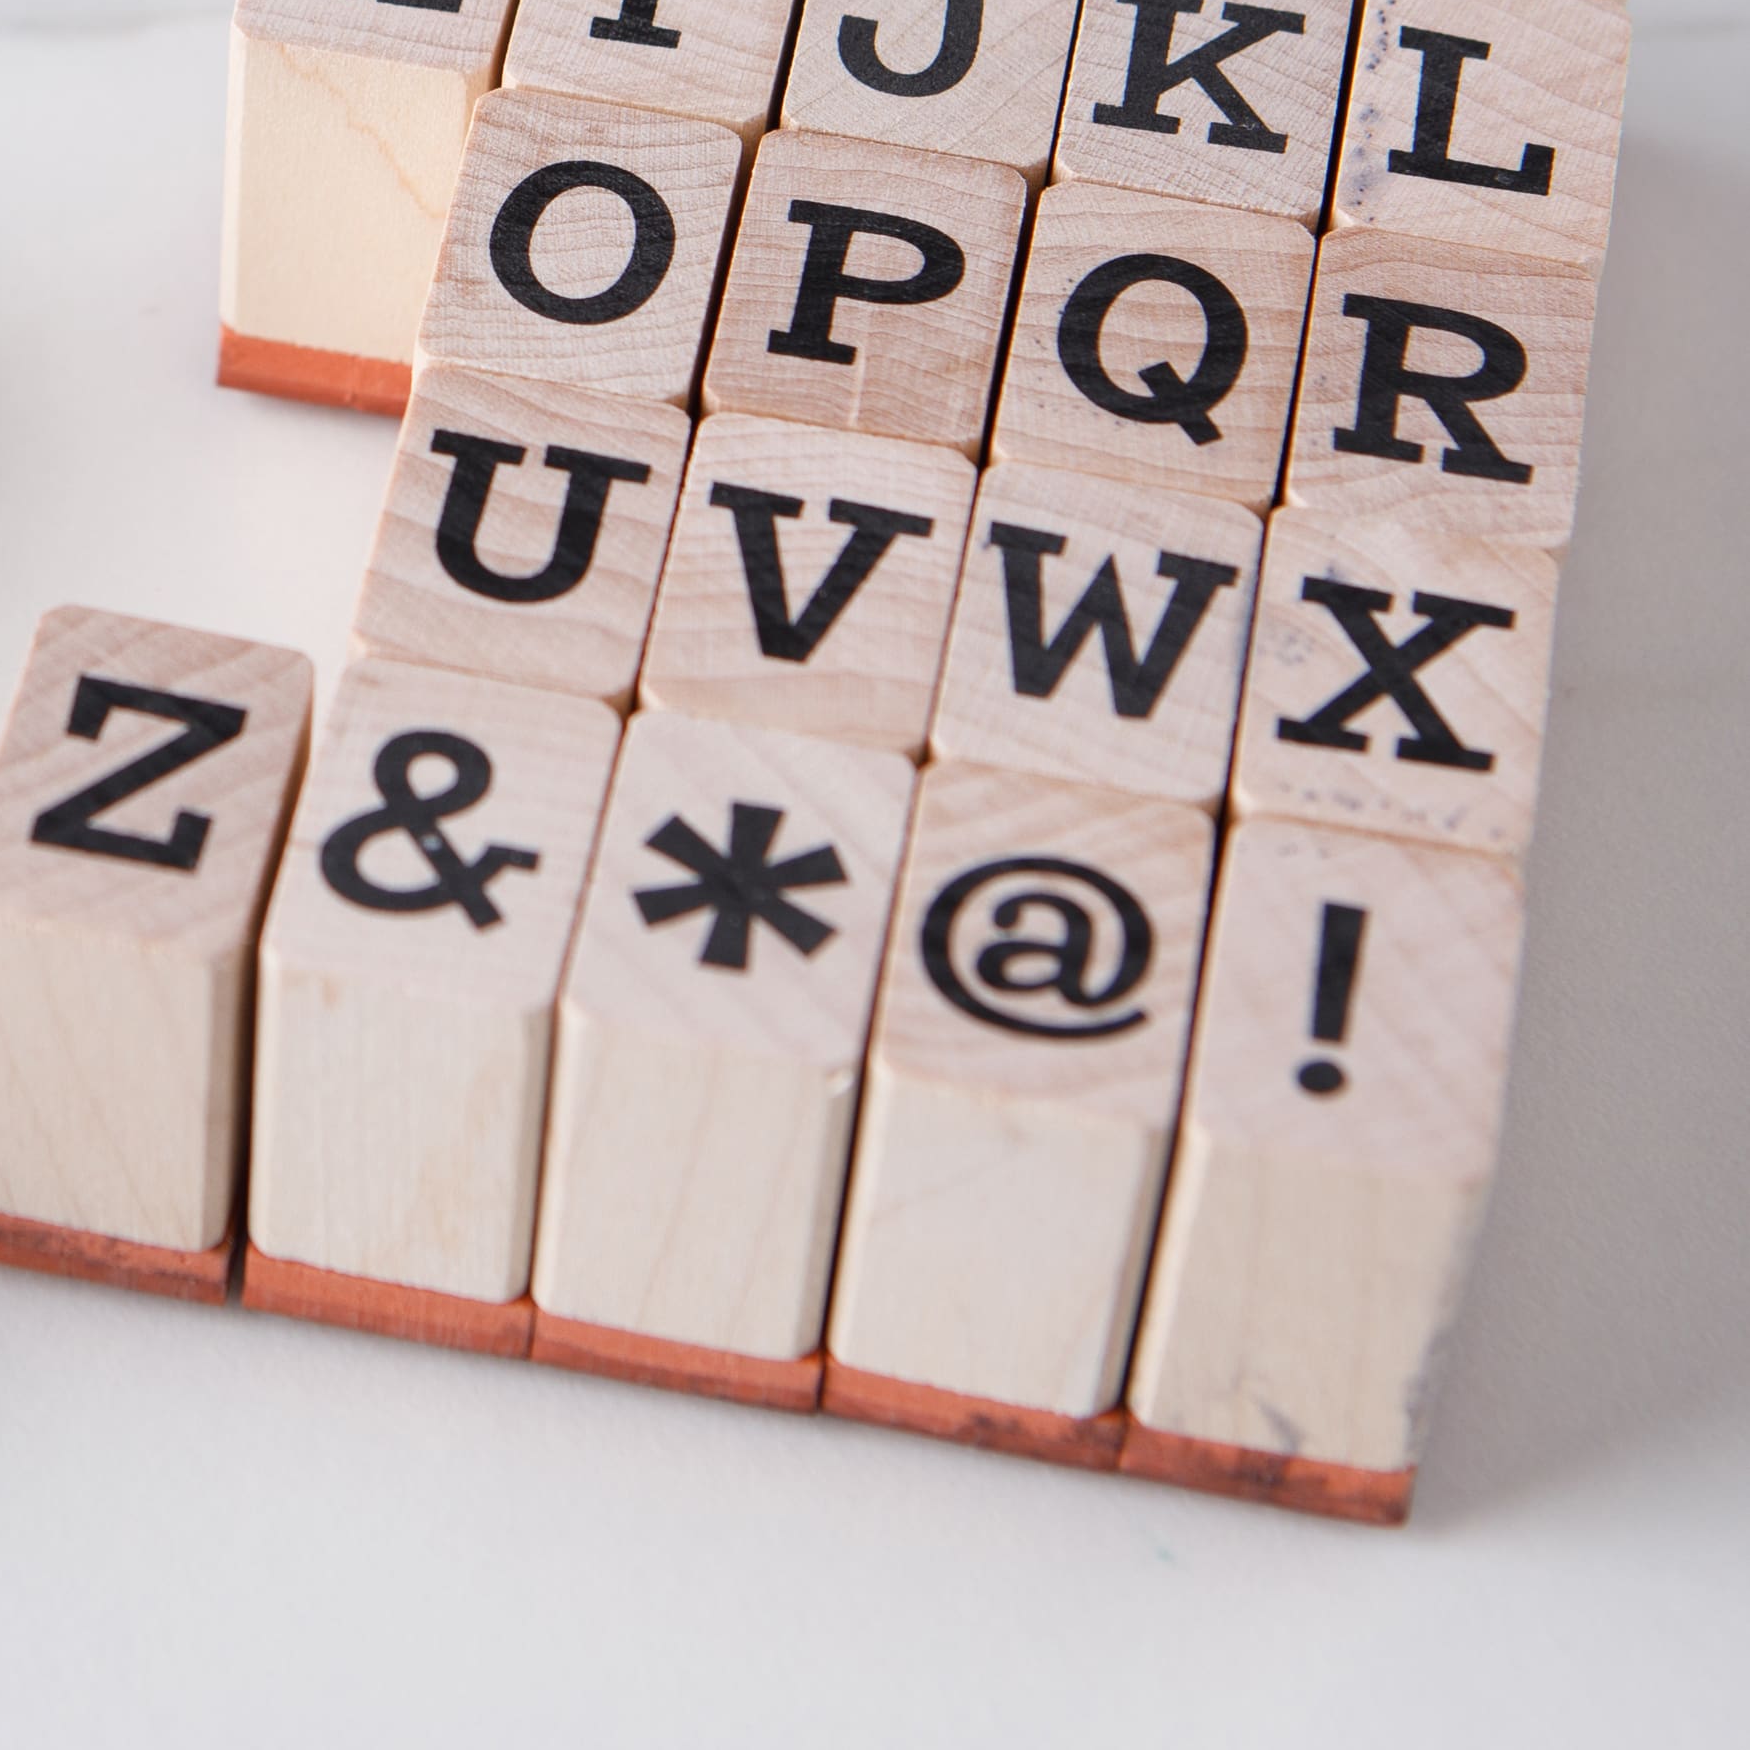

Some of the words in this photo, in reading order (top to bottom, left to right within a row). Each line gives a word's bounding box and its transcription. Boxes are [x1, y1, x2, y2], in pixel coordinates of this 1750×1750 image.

[1388, 26, 1554, 196] L
[489, 161, 675, 324] O
[767, 200, 964, 365] P
[1058, 254, 1247, 445] Q
[1334, 293, 1531, 483] R
[431, 429, 650, 602] U
[710, 482, 932, 662] V
[990, 522, 1237, 718] W
[1278, 577, 1513, 771] X
[31, 676, 246, 871] Z
[321, 732, 537, 927] &
[920, 858, 1152, 1039] @
